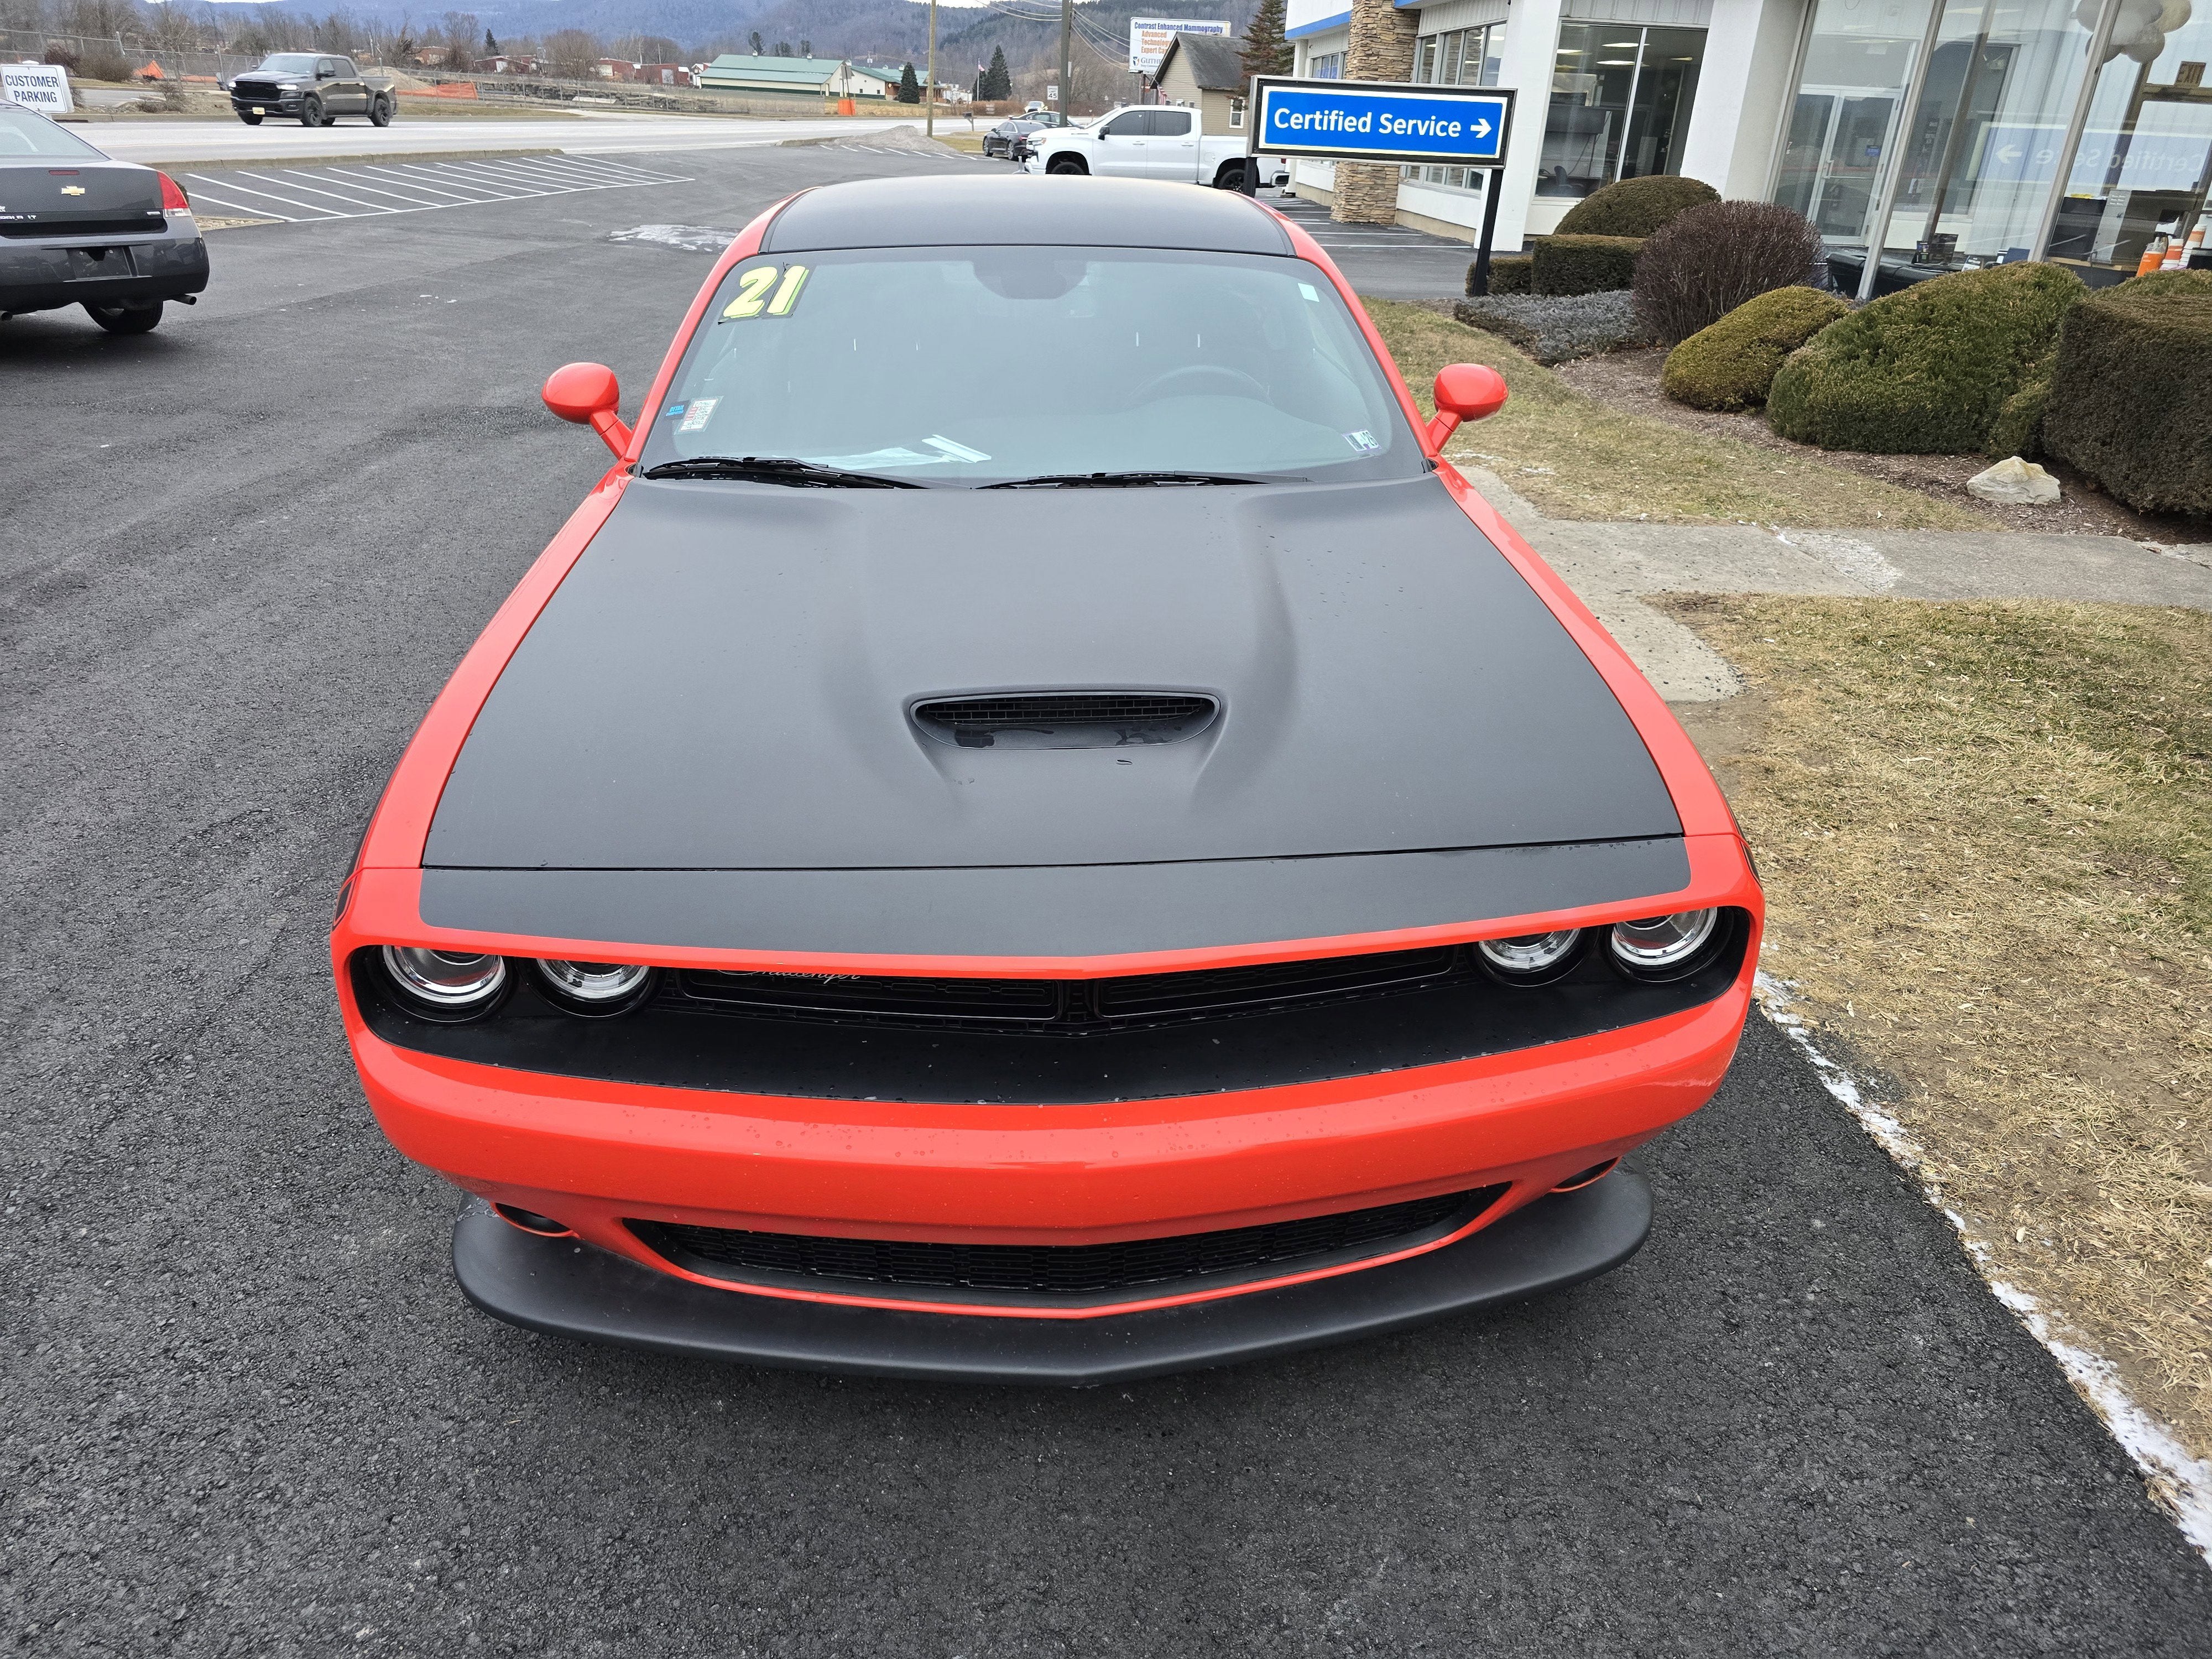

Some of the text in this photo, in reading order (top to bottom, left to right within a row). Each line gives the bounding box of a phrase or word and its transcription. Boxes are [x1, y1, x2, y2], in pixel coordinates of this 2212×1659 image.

[1134, 22, 1223, 34] Contrast Enhanced Mammography
[1141, 46, 1157, 54] Expert
[2176, 62, 2206, 84] EXIT
[5, 75, 59, 87] CUSTOMER
[13, 90, 58, 103] PARKING
[1274, 107, 1462, 137] Certified Service
[723, 265, 809, 319] 21
